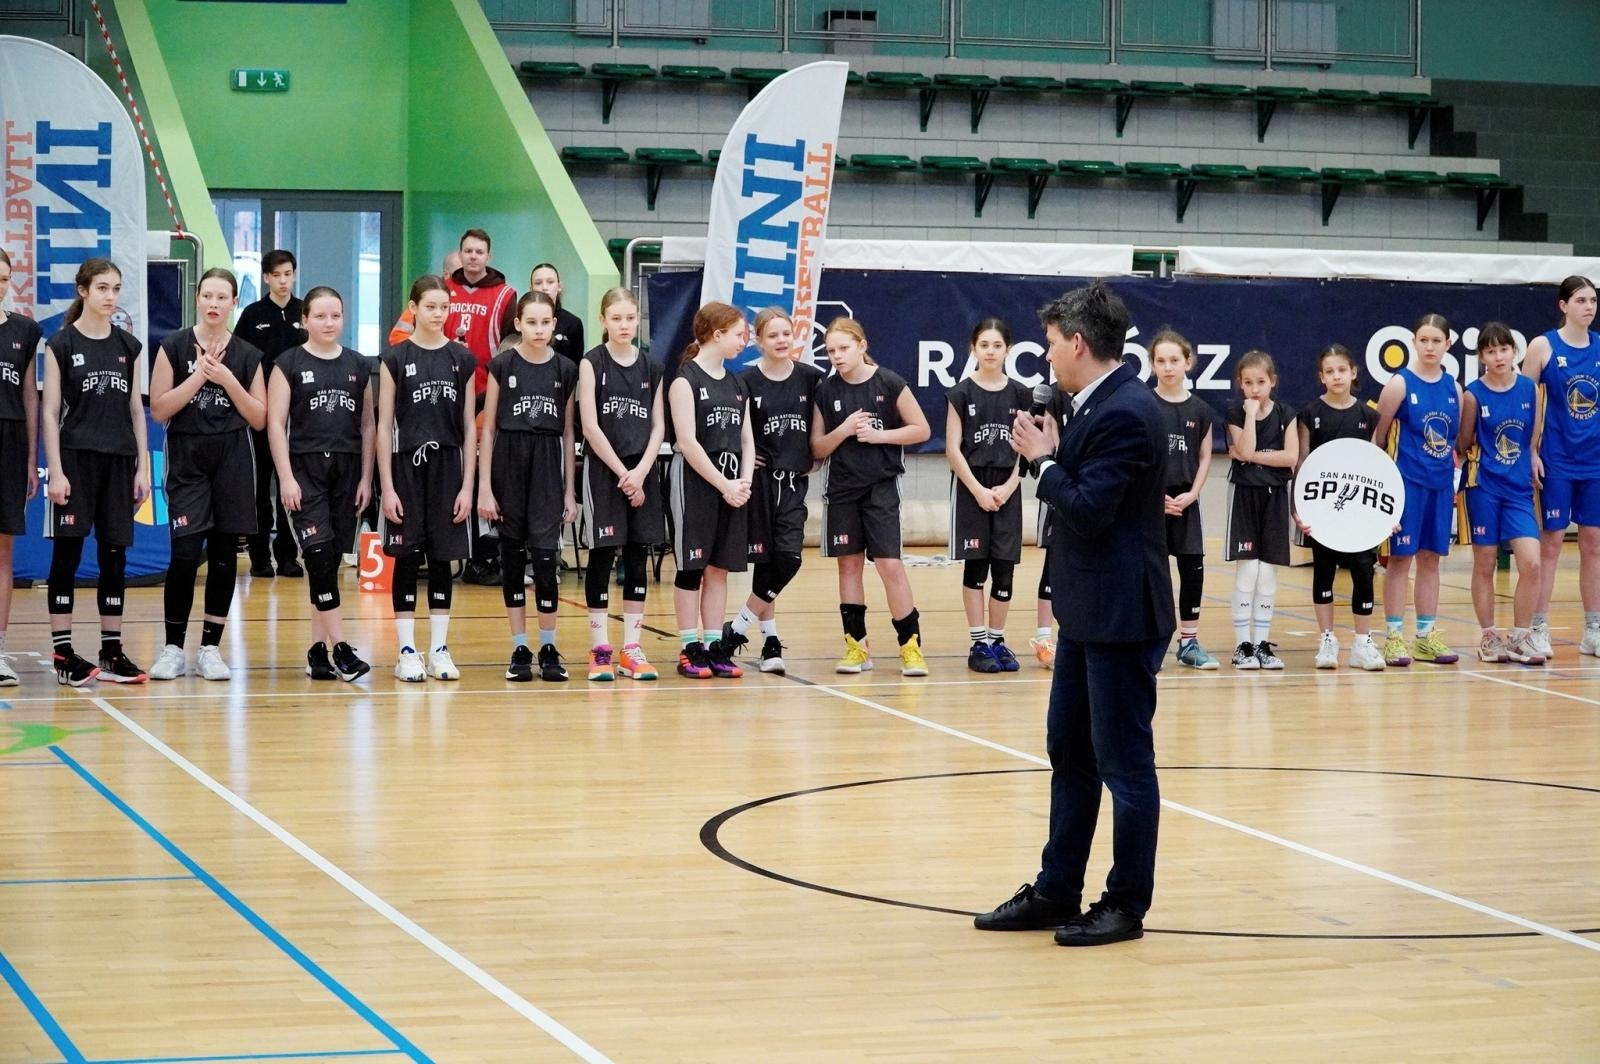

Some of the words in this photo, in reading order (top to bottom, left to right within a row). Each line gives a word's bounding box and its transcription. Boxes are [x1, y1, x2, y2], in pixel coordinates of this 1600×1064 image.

[450, 302, 488, 316] ROCKETS
[461, 313, 472, 331] 13
[301, 370, 315, 384] 12
[405, 363, 417, 377] 10
[82, 376, 128, 395] SPURS
[309, 395, 356, 413] SPURS
[412, 386, 457, 405] SPURS
[754, 396, 762, 409] 7
[513, 400, 558, 419] SPURS
[602, 401, 648, 419] SPURS
[968, 403, 977, 417] 5
[707, 411, 741, 430] SPUR
[763, 418, 807, 437] SPURS
[1341, 472, 1384, 489] ANTONIO
[1303, 481, 1395, 515] SPURS
[361, 539, 383, 578] 5
